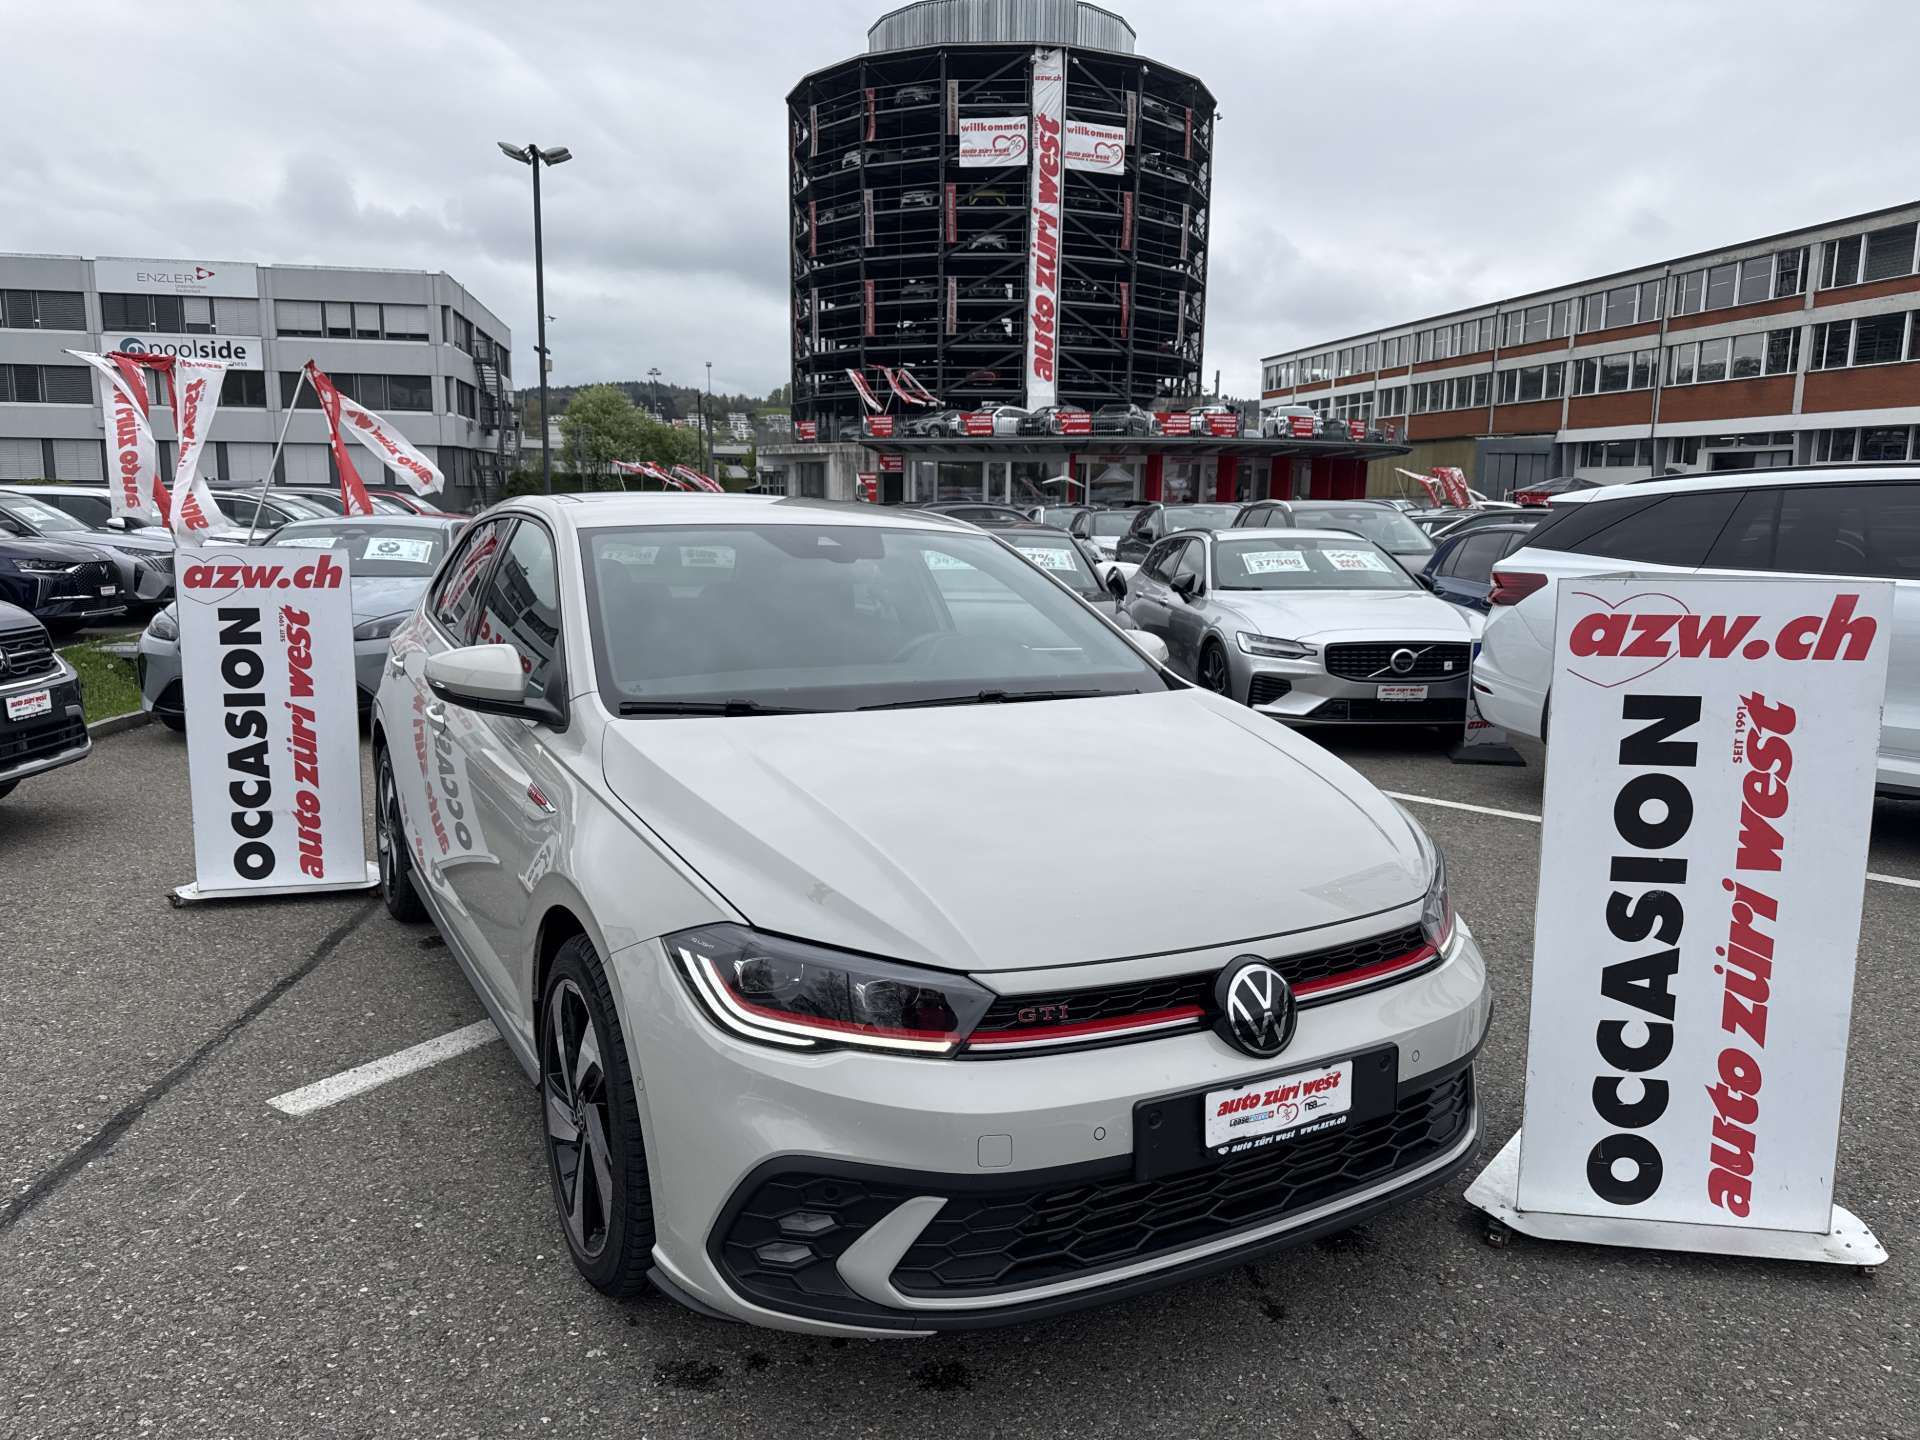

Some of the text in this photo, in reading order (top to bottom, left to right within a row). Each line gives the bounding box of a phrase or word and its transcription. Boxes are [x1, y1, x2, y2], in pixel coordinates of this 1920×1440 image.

[961, 122, 1026, 132] willkommen
[1067, 126, 1124, 140] willkommen
[1030, 112, 1061, 382] auto züri west
[137, 272, 194, 284] ENZLER
[149, 339, 247, 361] poolside
[183, 555, 344, 589] azw.ch
[1569, 593, 1878, 662] azw.ch
[217, 607, 276, 881] OCCASION
[280, 604, 325, 880] auto züri west
[1732, 704, 1747, 764] SEIT 1991
[1586, 694, 1703, 1206] OCCASION
[1704, 690, 1797, 1218] auto züri west
[1018, 1004, 1069, 1023] GTI
[1217, 1071, 1342, 1117] auto züri west
[1231, 1142, 1253, 1153] auto
[1275, 1130, 1296, 1141] west
